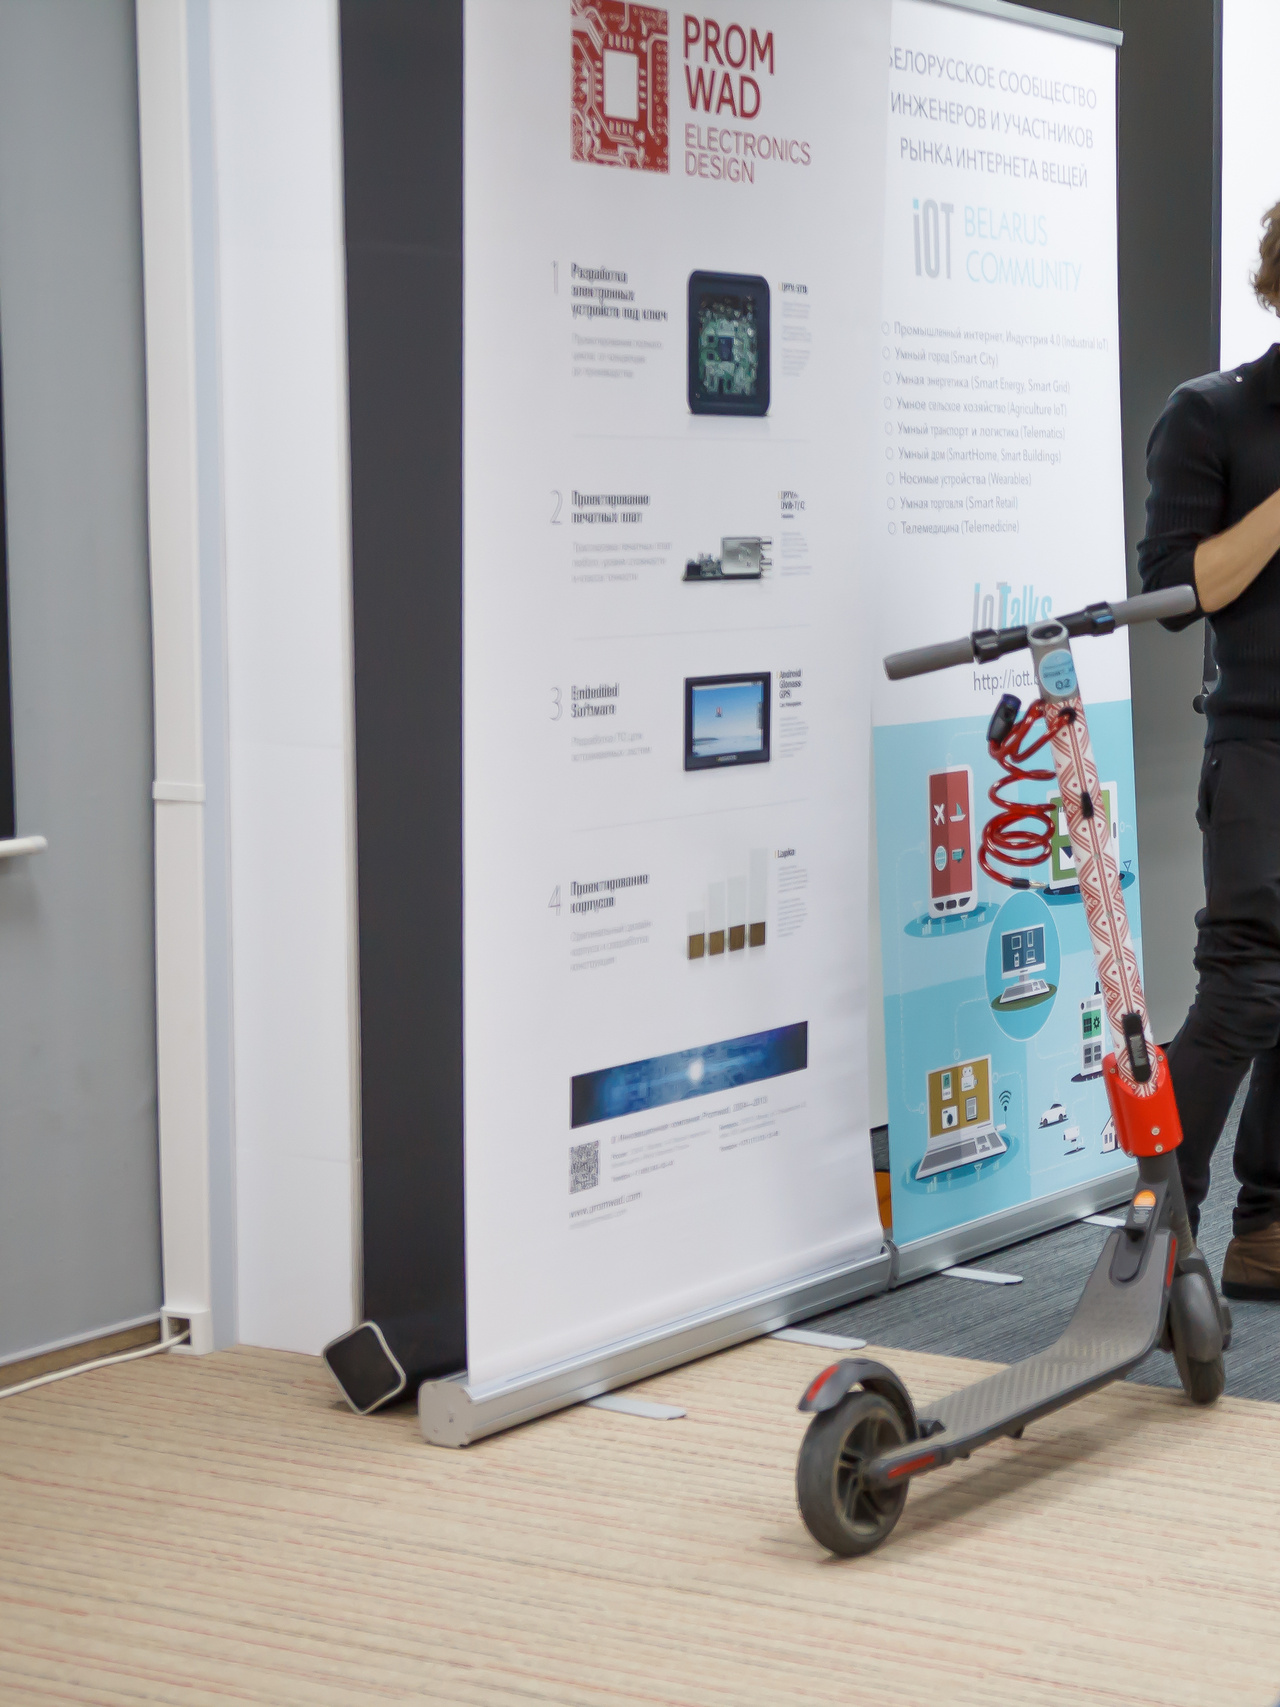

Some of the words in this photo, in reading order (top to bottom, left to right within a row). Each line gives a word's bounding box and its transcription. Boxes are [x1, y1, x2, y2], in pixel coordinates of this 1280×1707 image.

[683, 14, 774, 75] PROM
[684, 65, 762, 120] WAD
[999, 69, 1098, 109] СООБЩЕСТВО
[891, 91, 987, 130] ИНЖЕНЕРОВ
[991, 109, 1000, 132] И
[1003, 111, 1094, 150] УЧАСТНИКОВ
[684, 123, 812, 166] ELECTRONICS
[900, 137, 953, 167] РЫНКА
[956, 146, 1039, 180] ИНТЕРНЕТА
[1041, 160, 1088, 189] ВЕЩЕЙ
[684, 150, 755, 184] DESIGN
[963, 205, 1049, 246] BELARUS
[965, 250, 1082, 292] COMMUNITY
[550, 489, 563, 525] 2
[973, 668, 1039, 696] http://iott.b
[550, 686, 563, 721] 3
[548, 884, 562, 916] 4
